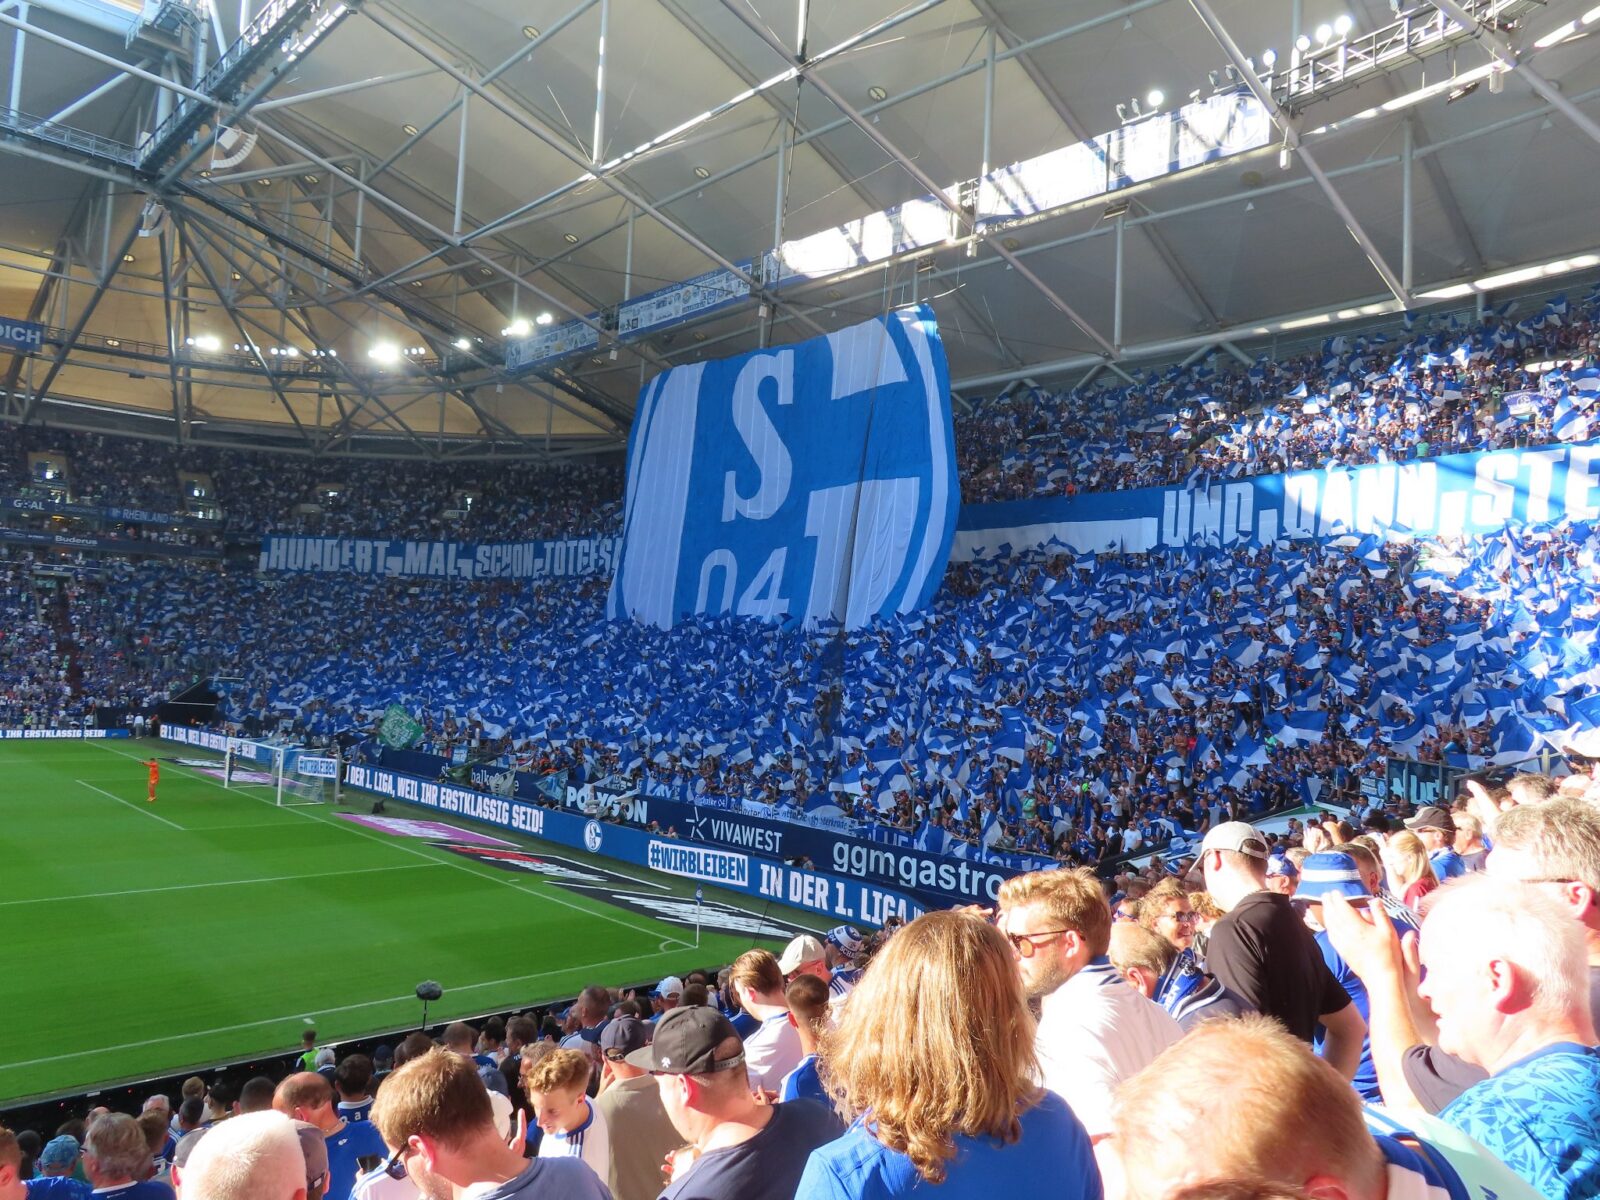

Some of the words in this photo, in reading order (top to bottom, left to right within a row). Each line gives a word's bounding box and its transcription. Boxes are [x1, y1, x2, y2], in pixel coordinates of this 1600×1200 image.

[350, 766, 365, 787] DER
[374, 771, 396, 798] LIGA,
[397, 776, 419, 801] WEIL
[421, 782, 439, 806] IHR
[440, 787, 510, 825] ERSTKLASSIG
[512, 805, 544, 835] SEID!
[711, 818, 783, 853] VIVAWEST
[650, 843, 747, 883] #WIRBLEIBEN
[759, 863, 784, 899] IN
[789, 870, 829, 911] DER
[834, 881, 854, 917] 1.
